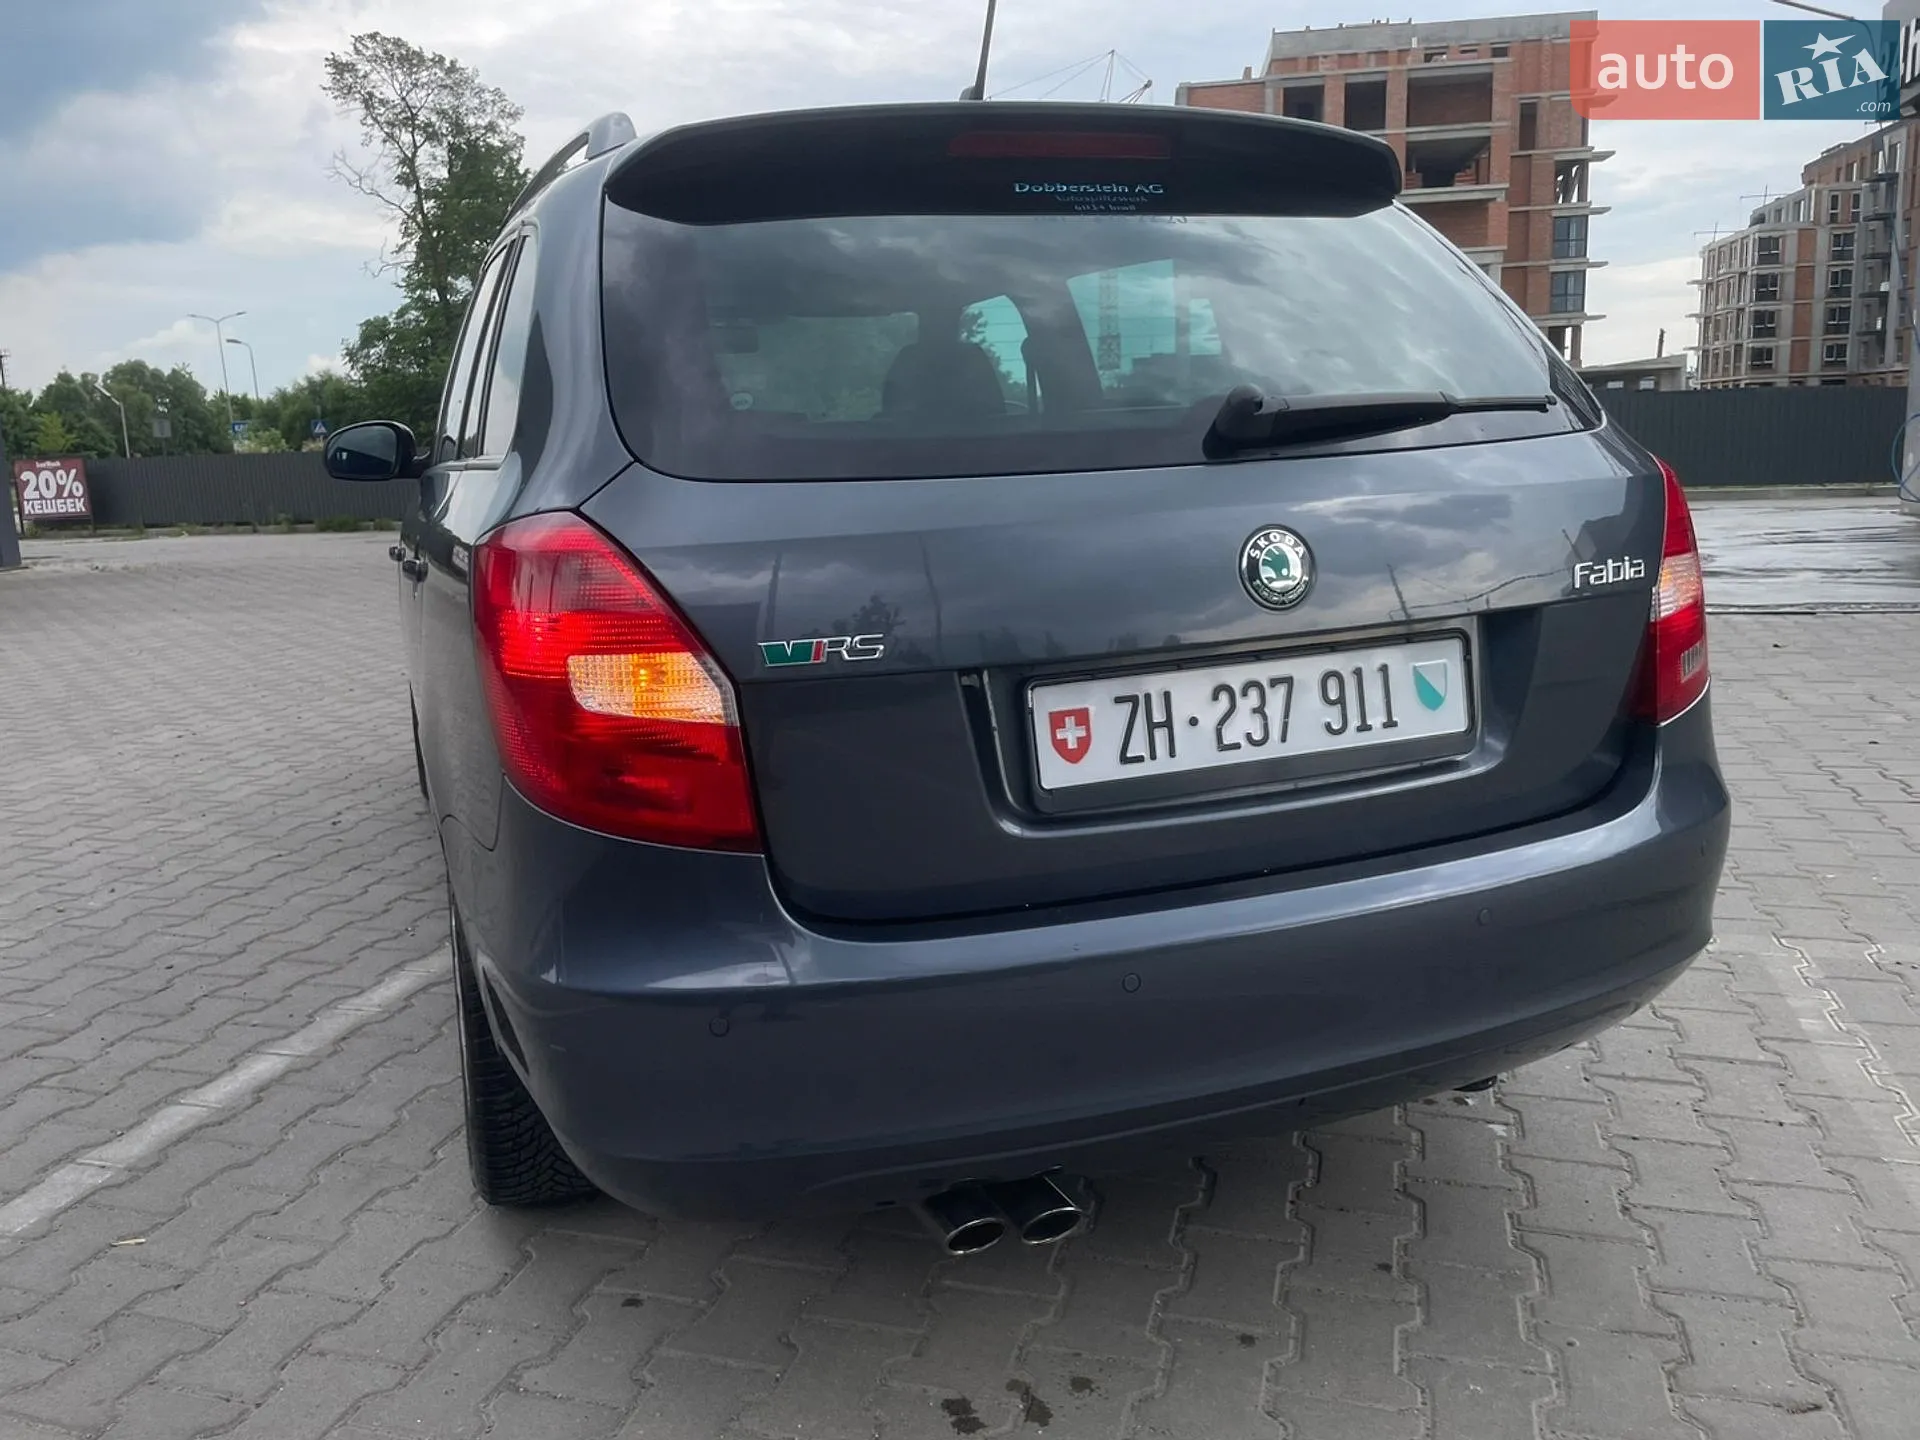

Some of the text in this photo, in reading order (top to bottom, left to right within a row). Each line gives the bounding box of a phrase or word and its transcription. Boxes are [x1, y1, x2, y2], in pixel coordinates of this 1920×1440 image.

[1014, 183, 1164, 194] Dobberstein AG
[20, 469, 84, 499] 20%
[23, 498, 86, 515] КЕШБЕК
[1574, 556, 1645, 588] Fabia
[1211, 675, 1294, 752] 237
[1320, 663, 1398, 736] 911
